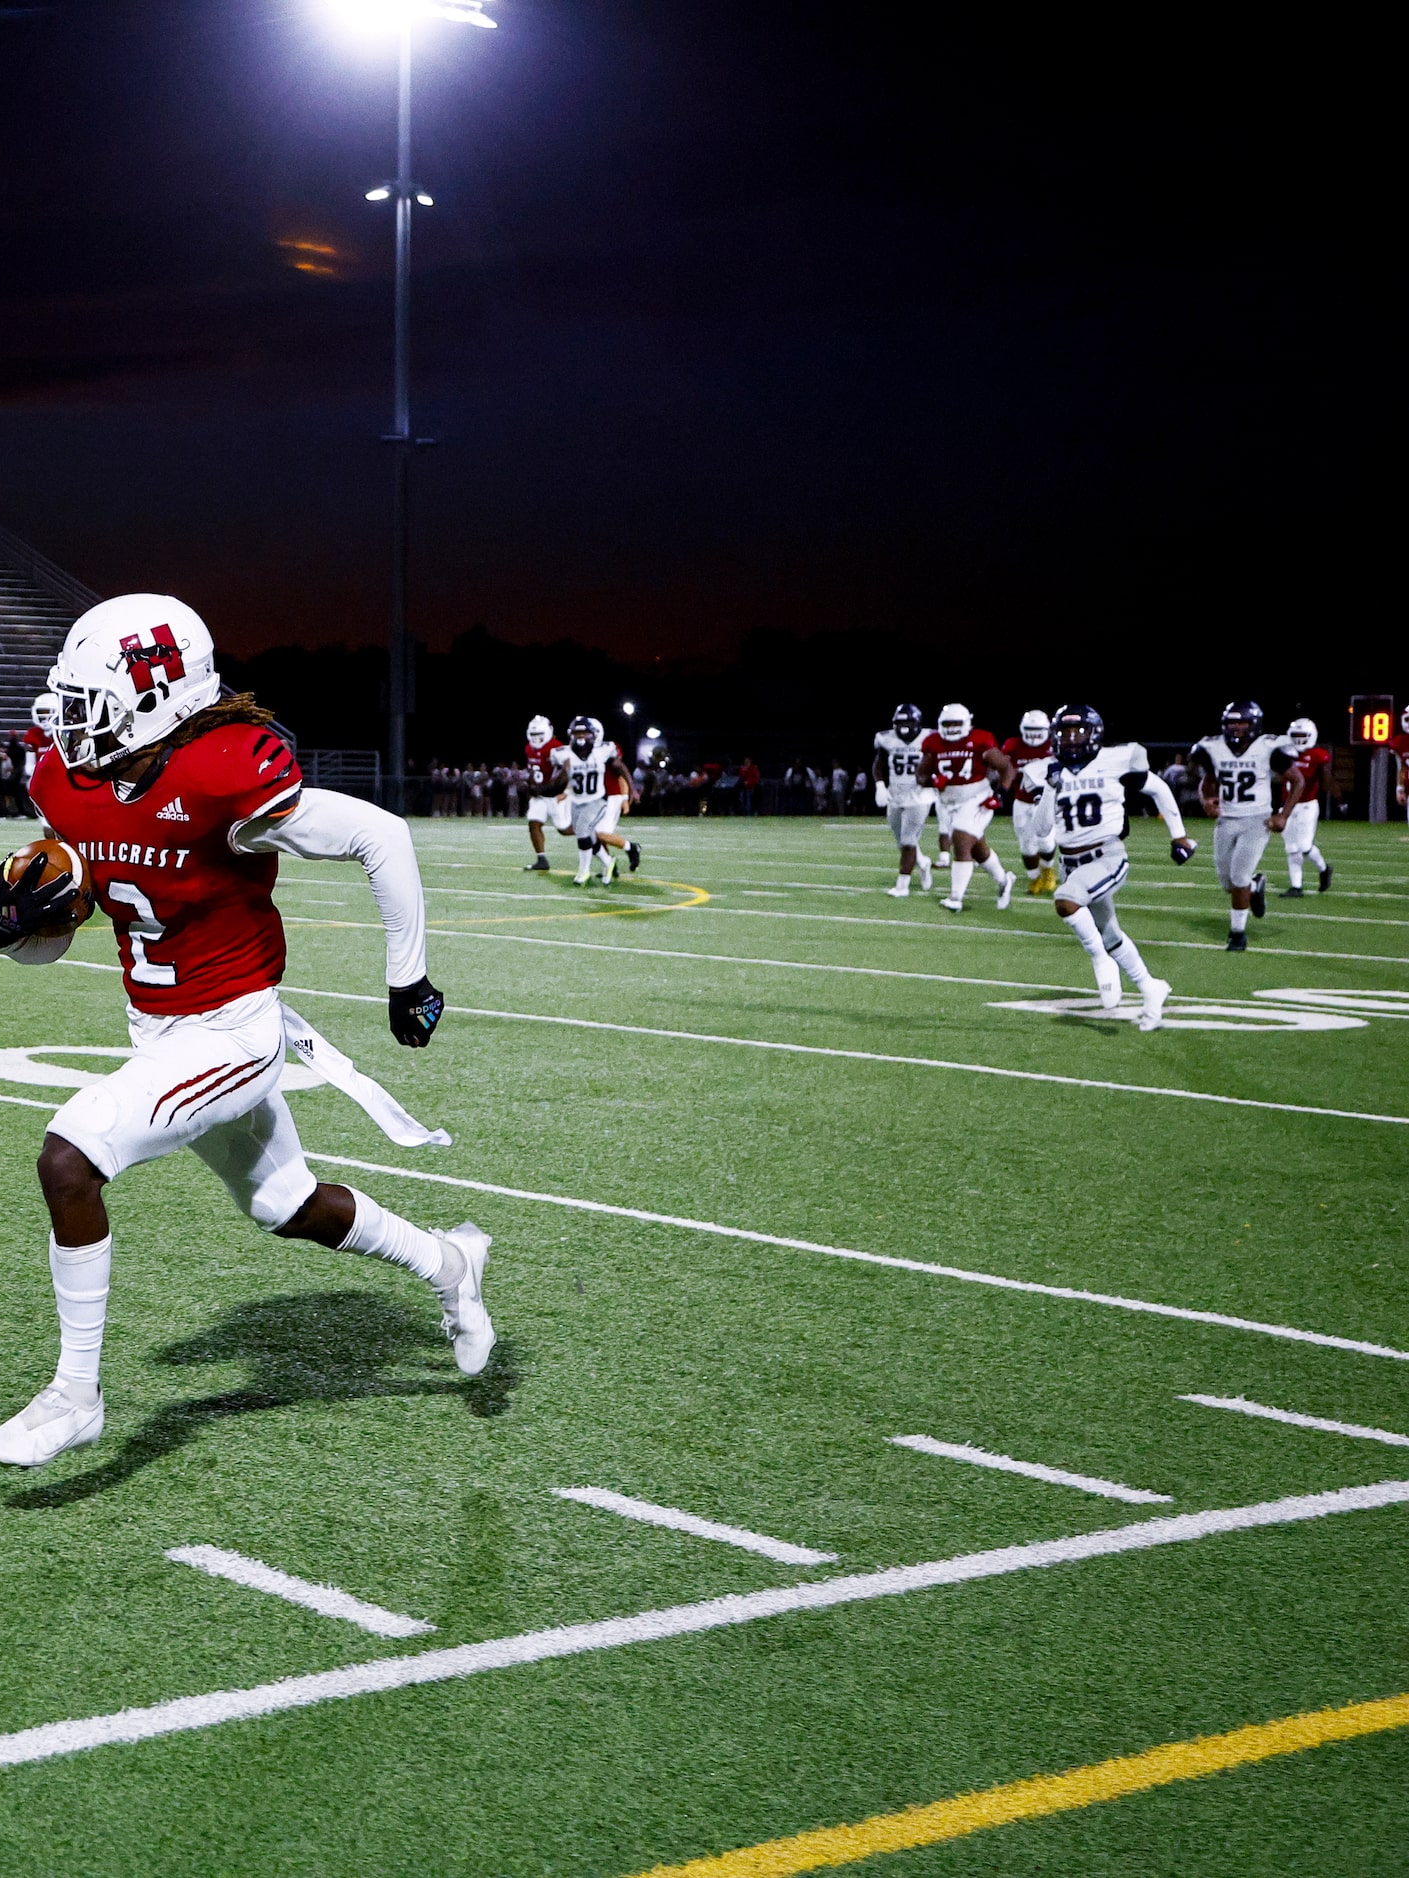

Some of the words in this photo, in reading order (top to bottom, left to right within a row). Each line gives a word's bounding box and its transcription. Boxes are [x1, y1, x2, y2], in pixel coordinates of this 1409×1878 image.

[119, 623, 186, 694] H
[1363, 712, 1389, 742] 18
[572, 771, 599, 795] 30
[938, 759, 974, 781] 54
[1063, 777, 1105, 792] OLVES
[1218, 770, 1257, 803] 52
[156, 810, 190, 821] adidas
[1057, 793, 1103, 832] 10
[78, 841, 190, 868] HILLCREST
[108, 881, 177, 987] 2
